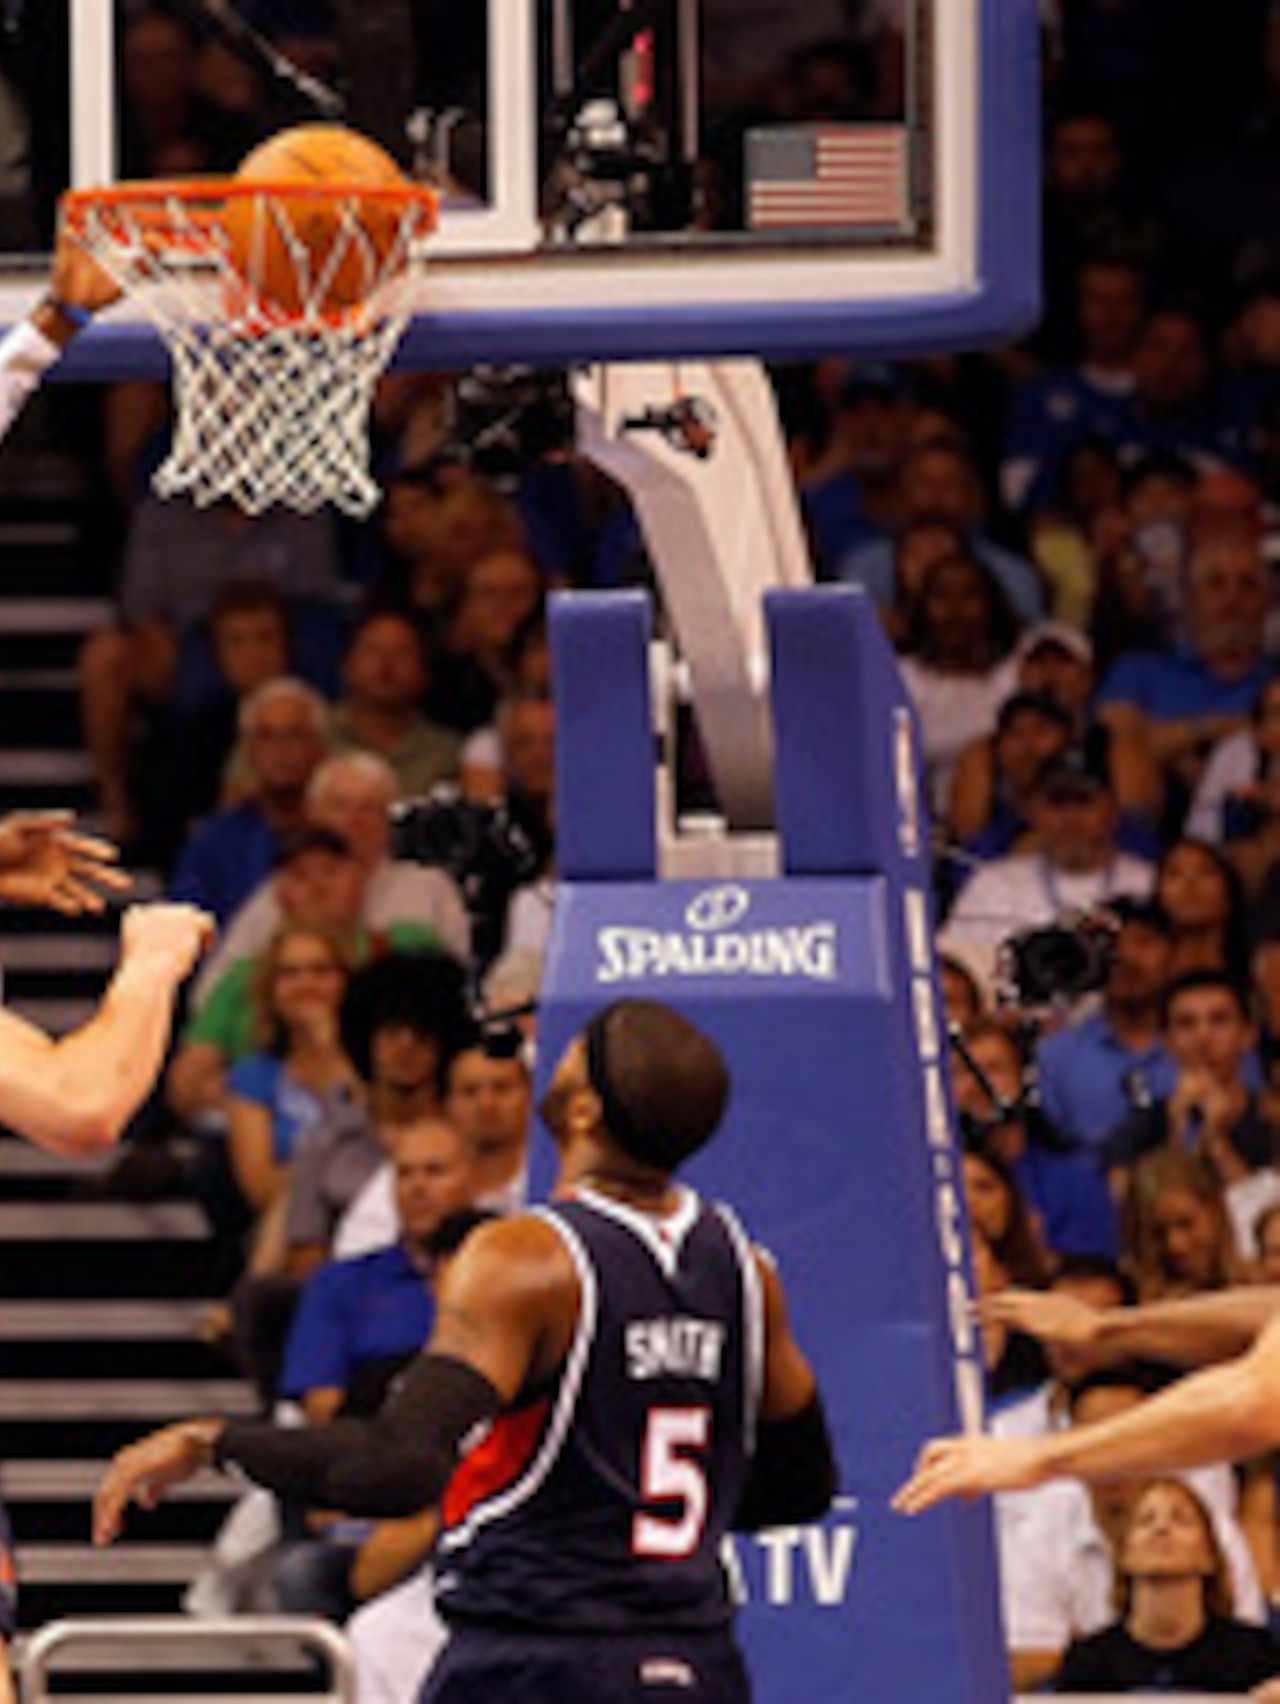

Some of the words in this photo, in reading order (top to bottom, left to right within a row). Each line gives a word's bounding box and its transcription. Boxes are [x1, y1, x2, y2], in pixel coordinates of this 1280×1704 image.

[596, 921, 839, 983] SPALDING
[625, 1318, 725, 1381] SMITH
[631, 1404, 713, 1559] 5
[756, 1525, 856, 1605] TV
